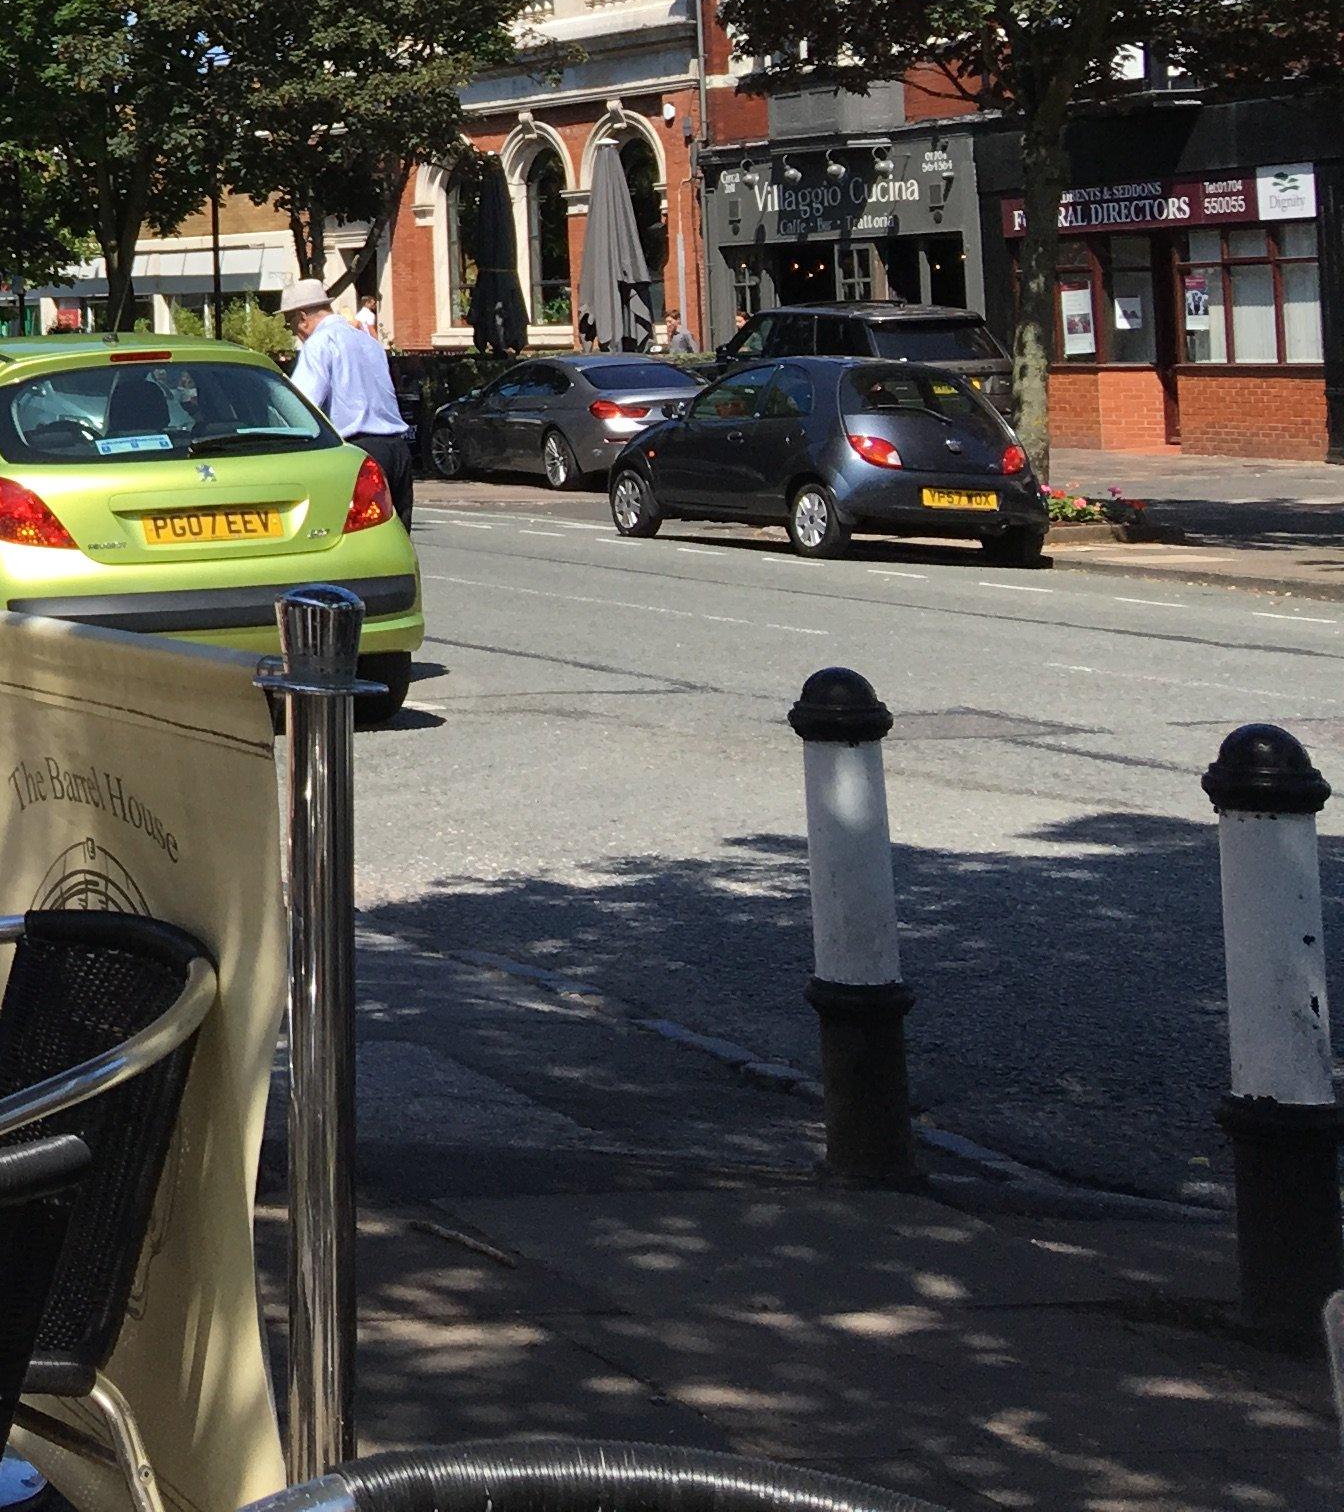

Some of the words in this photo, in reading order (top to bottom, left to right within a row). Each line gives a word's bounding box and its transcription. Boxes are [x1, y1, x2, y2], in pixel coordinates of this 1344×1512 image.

[754, 181, 841, 219] Villaggio
[849, 174, 920, 204] Cucina
[1113, 182, 1162, 198] SEDDONS
[1269, 195, 1306, 212] Dignity
[1091, 196, 1190, 225] DIRECTORS
[1204, 196, 1246, 214] 550055
[153, 514, 222, 539] PG07
[226, 511, 270, 534] EEV
[8, 761, 47, 810] The
[44, 757, 107, 810] Barrel
[104, 772, 179, 863] House
